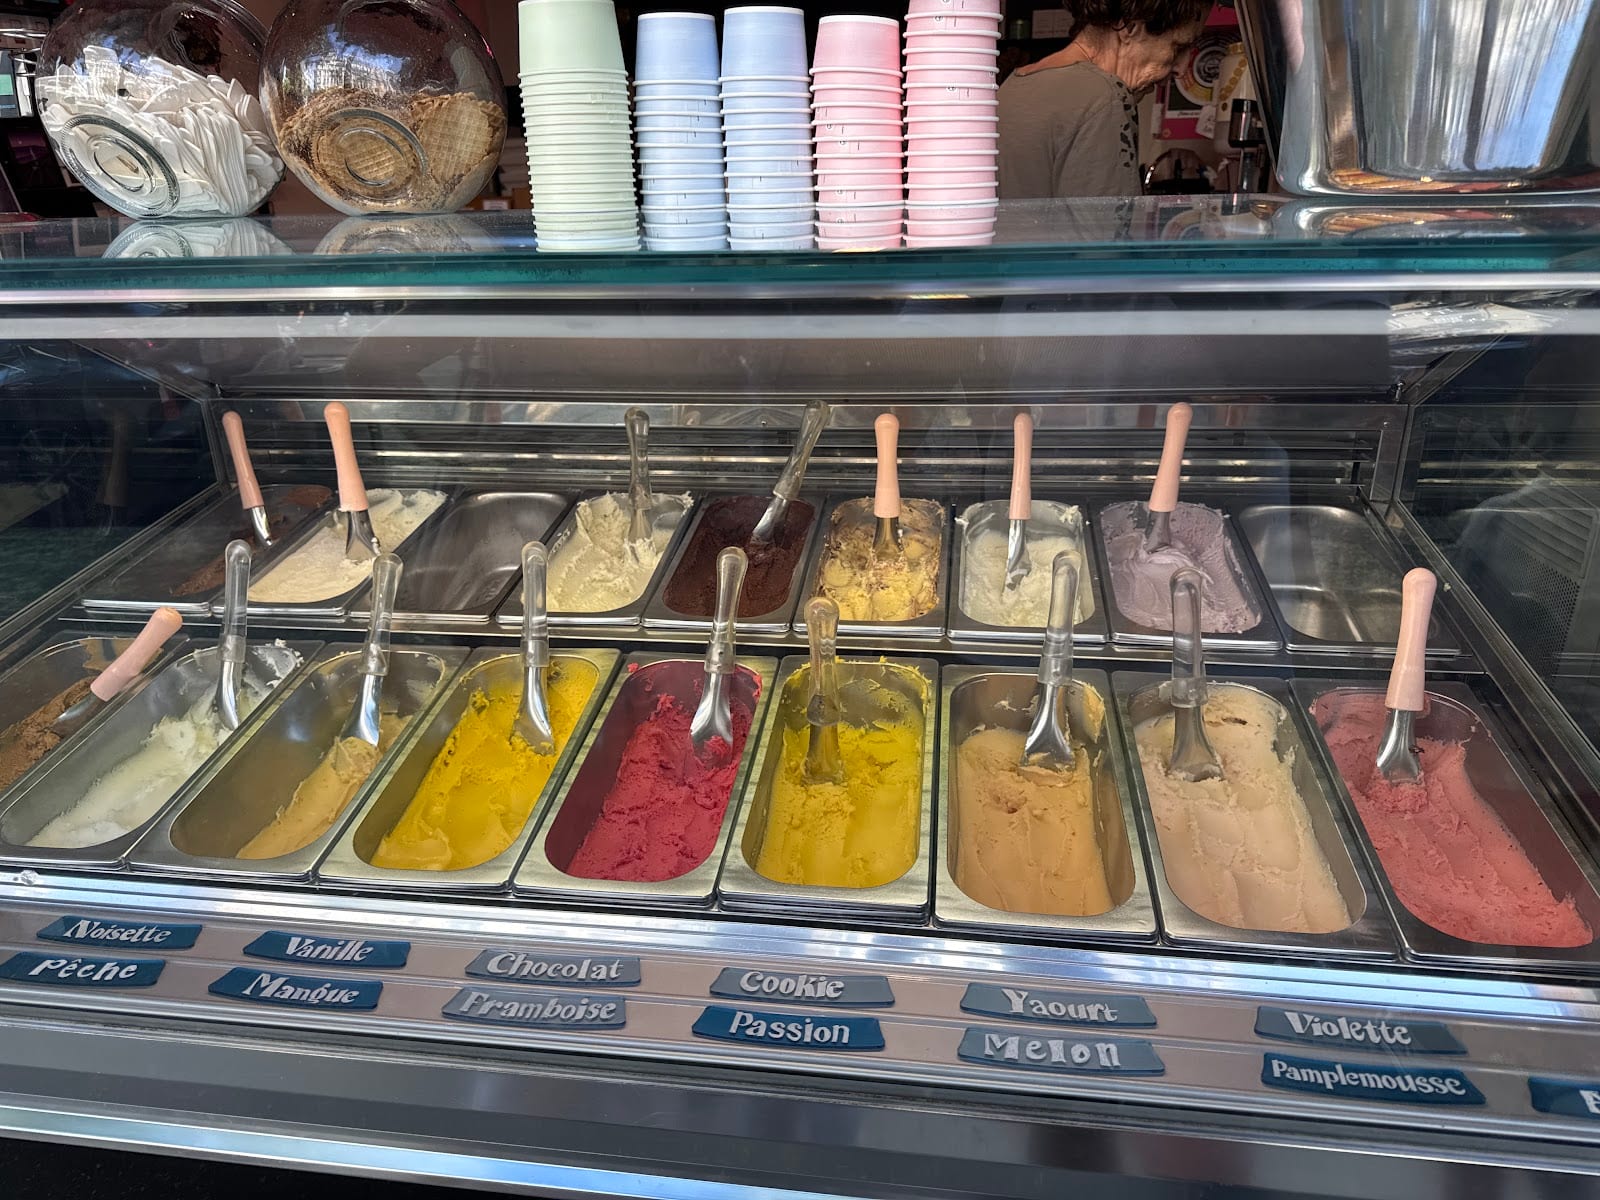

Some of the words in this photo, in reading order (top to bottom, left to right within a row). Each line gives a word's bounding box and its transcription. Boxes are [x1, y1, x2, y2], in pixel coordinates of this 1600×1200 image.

[63, 919, 172, 943] Noisette
[284, 936, 374, 962] Vanille
[28, 958, 138, 981] Pêche
[486, 952, 624, 980] Chocolat
[242, 972, 360, 1004] Mangue
[739, 971, 846, 999] Cookie
[459, 991, 618, 1021] Framboise
[1001, 988, 1119, 1022] Yaourt
[729, 1011, 850, 1044] Passion
[1284, 1011, 1412, 1045] Violette
[983, 1033, 1122, 1068] Melon
[1271, 1059, 1467, 1096] Pamplemousse
